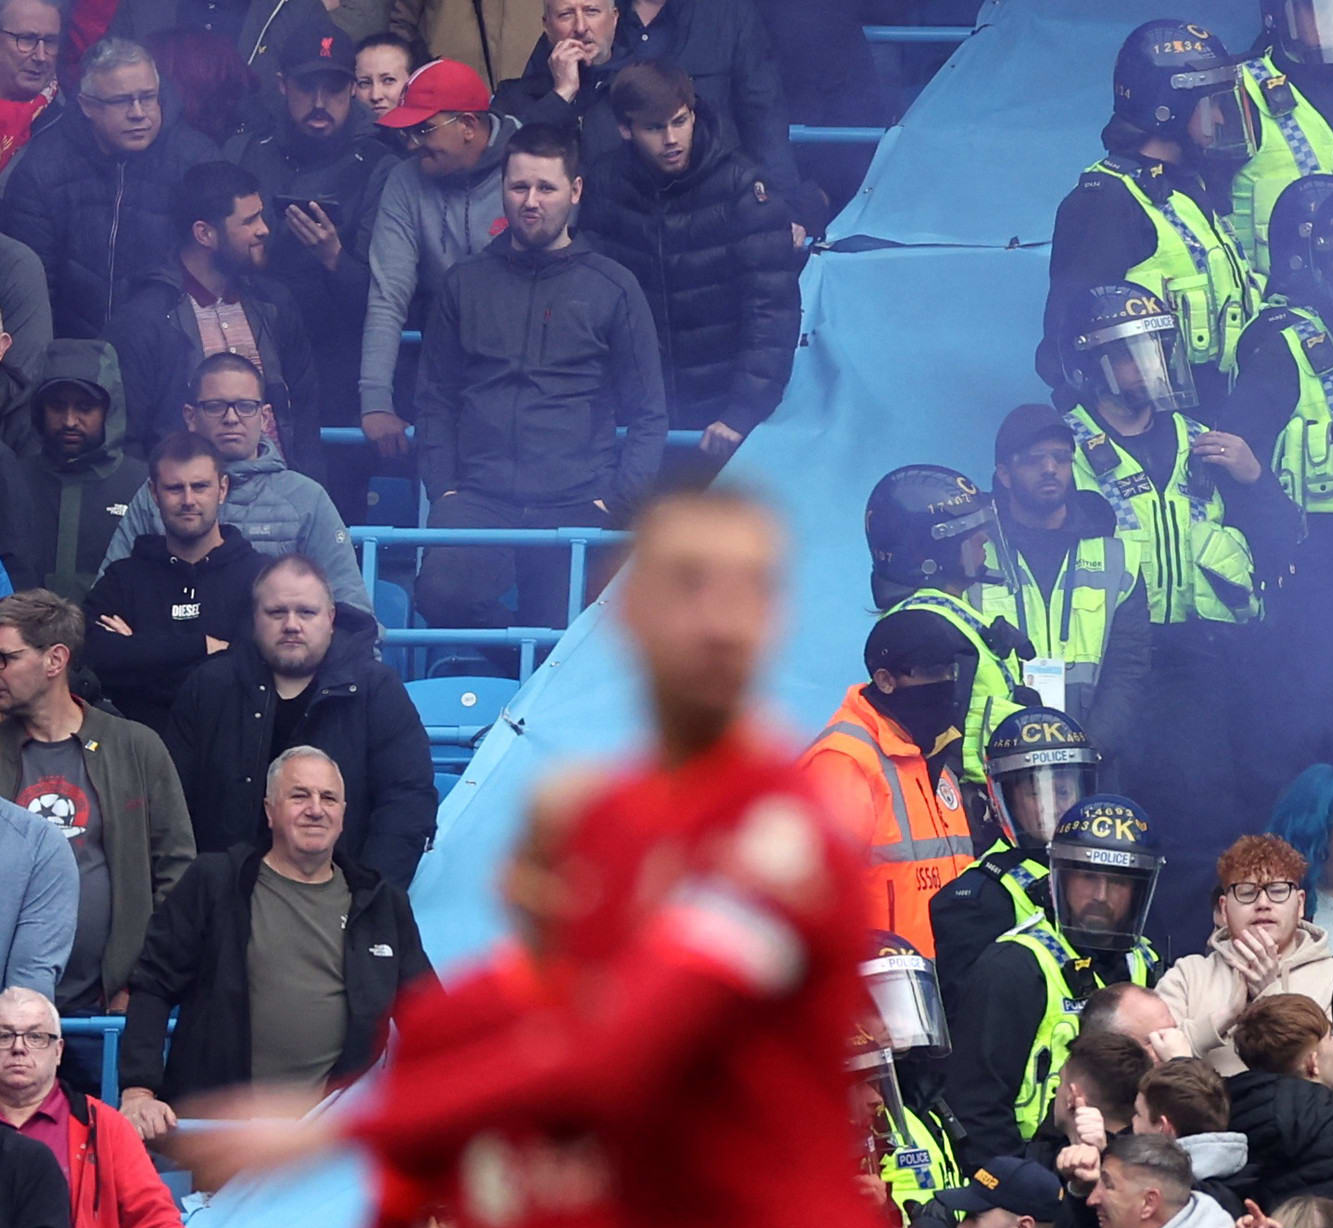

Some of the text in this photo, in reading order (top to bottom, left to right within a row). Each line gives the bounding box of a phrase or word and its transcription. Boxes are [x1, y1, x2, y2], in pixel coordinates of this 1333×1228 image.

[1126, 297, 1161, 316] CK
[172, 603, 201, 619] DIESEL
[1021, 723, 1066, 743] CK
[1032, 750, 1068, 764] POLICE
[1091, 816, 1136, 842] CK
[1092, 851, 1130, 866] POLICE
[899, 1152, 931, 1166] POLICE
